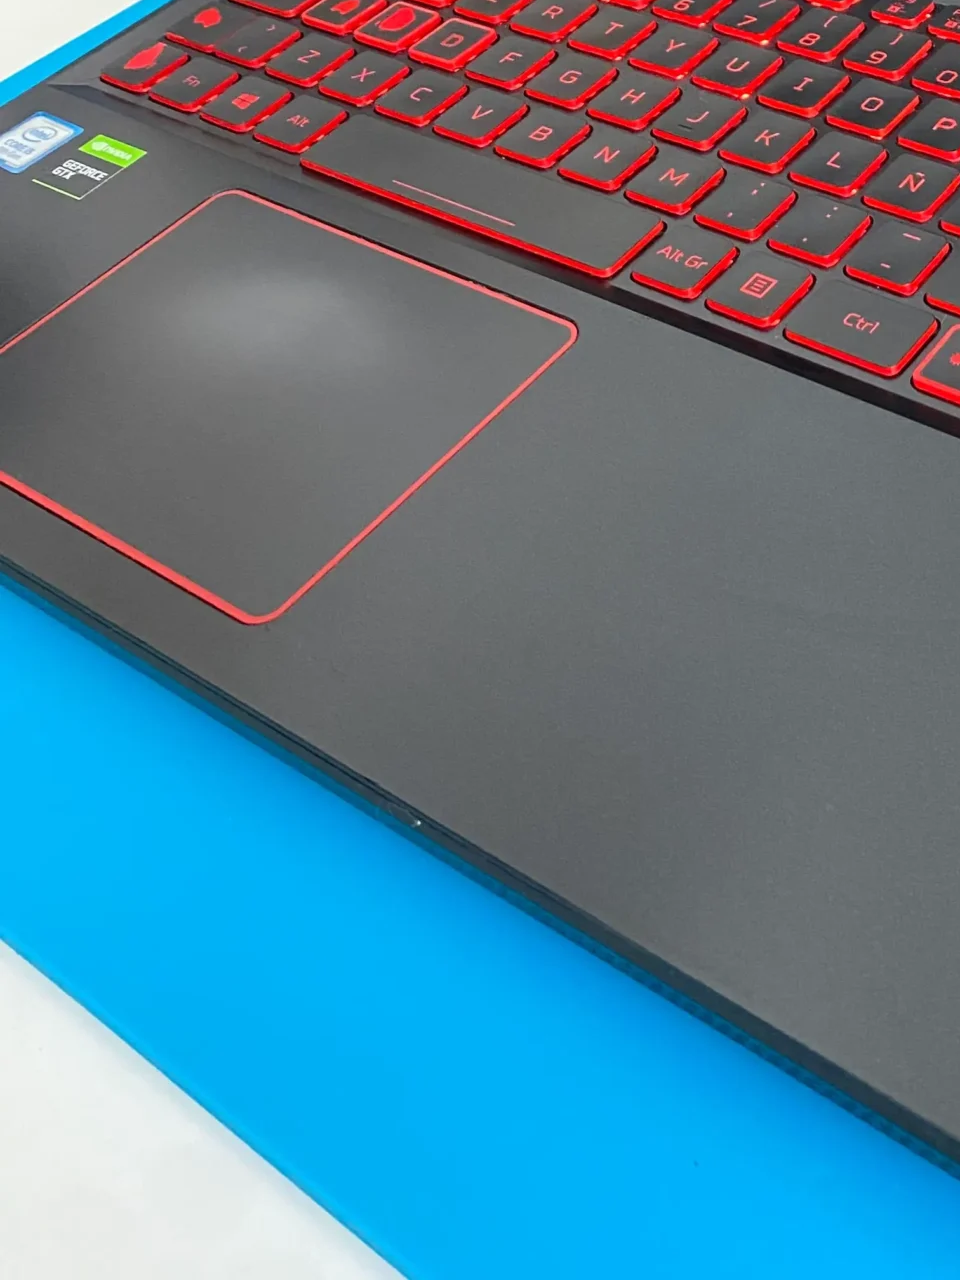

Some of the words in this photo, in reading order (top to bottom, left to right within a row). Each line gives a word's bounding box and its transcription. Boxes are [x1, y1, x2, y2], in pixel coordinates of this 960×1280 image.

[541, 5, 564, 19] R
[673, 0, 696, 11] 6
[604, 21, 624, 35] T
[737, 15, 758, 27] 7
[440, 33, 464, 48] D
[665, 38, 686, 53] Y
[799, 33, 821, 46] 8
[297, 49, 321, 63] Z
[499, 51, 523, 64] F
[865, 50, 888, 64] 9
[726, 57, 750, 73] U
[183, 75, 200, 87] Fn
[351, 67, 376, 82] X
[559, 70, 583, 84] G
[936, 69, 959, 84] 0
[792, 76, 814, 91] I
[410, 87, 433, 101] C
[620, 88, 646, 104] H
[860, 96, 884, 112] O
[471, 105, 494, 120] V
[686, 110, 710, 124] J
[286, 114, 310, 128] Alt
[932, 117, 958, 131] P
[528, 125, 553, 141] B
[754, 129, 780, 147] K
[593, 146, 621, 163] N
[826, 152, 841, 169] L
[52, 166, 77, 180] GTX
[62, 159, 109, 181] GEFORCE
[658, 167, 690, 186] M
[898, 172, 926, 193] Ñ
[656, 245, 682, 263] Alt
[684, 254, 709, 269] Gr
[843, 312, 881, 334] Ctrl
